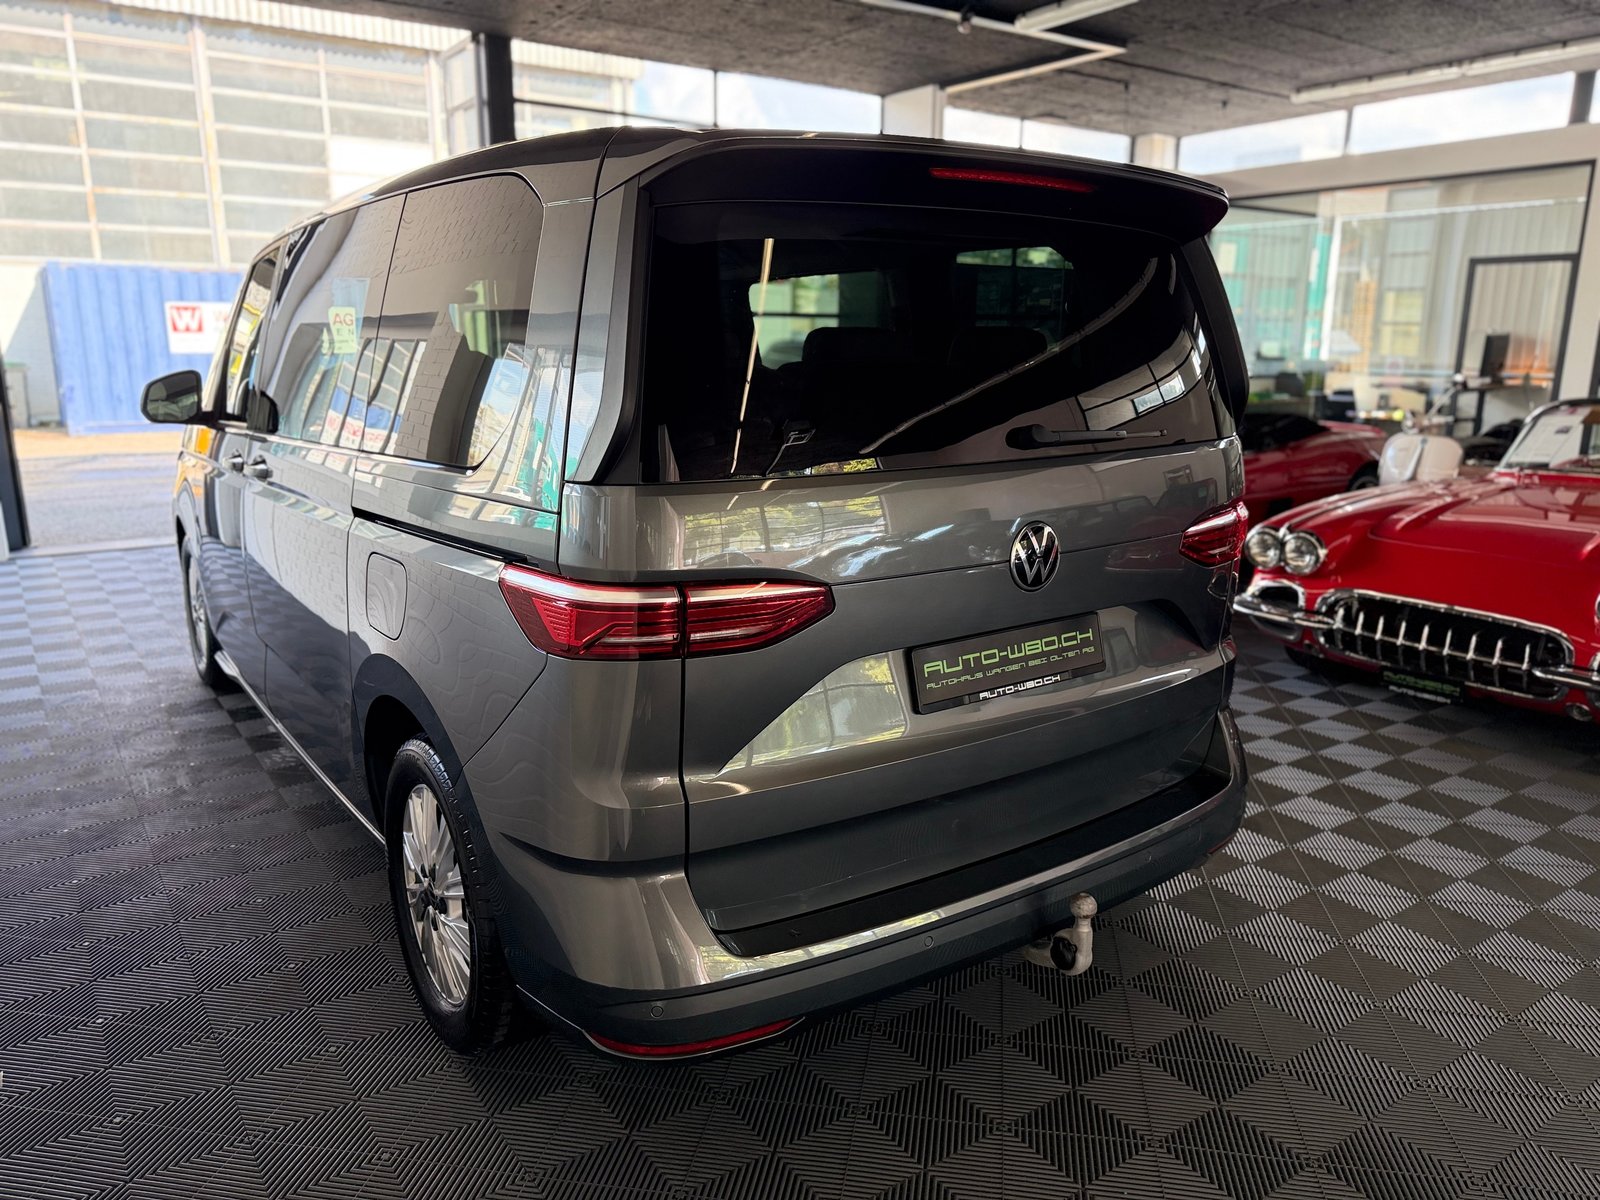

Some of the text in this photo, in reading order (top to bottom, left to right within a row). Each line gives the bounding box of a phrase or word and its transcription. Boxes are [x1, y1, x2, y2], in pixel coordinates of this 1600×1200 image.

[923, 628, 1093, 677] AUTO-WBO.CH
[926, 645, 1095, 690] AUTOHAUS WANGEN BEI OLTEN AG
[979, 674, 1061, 700] AUTO-WBO.CH
